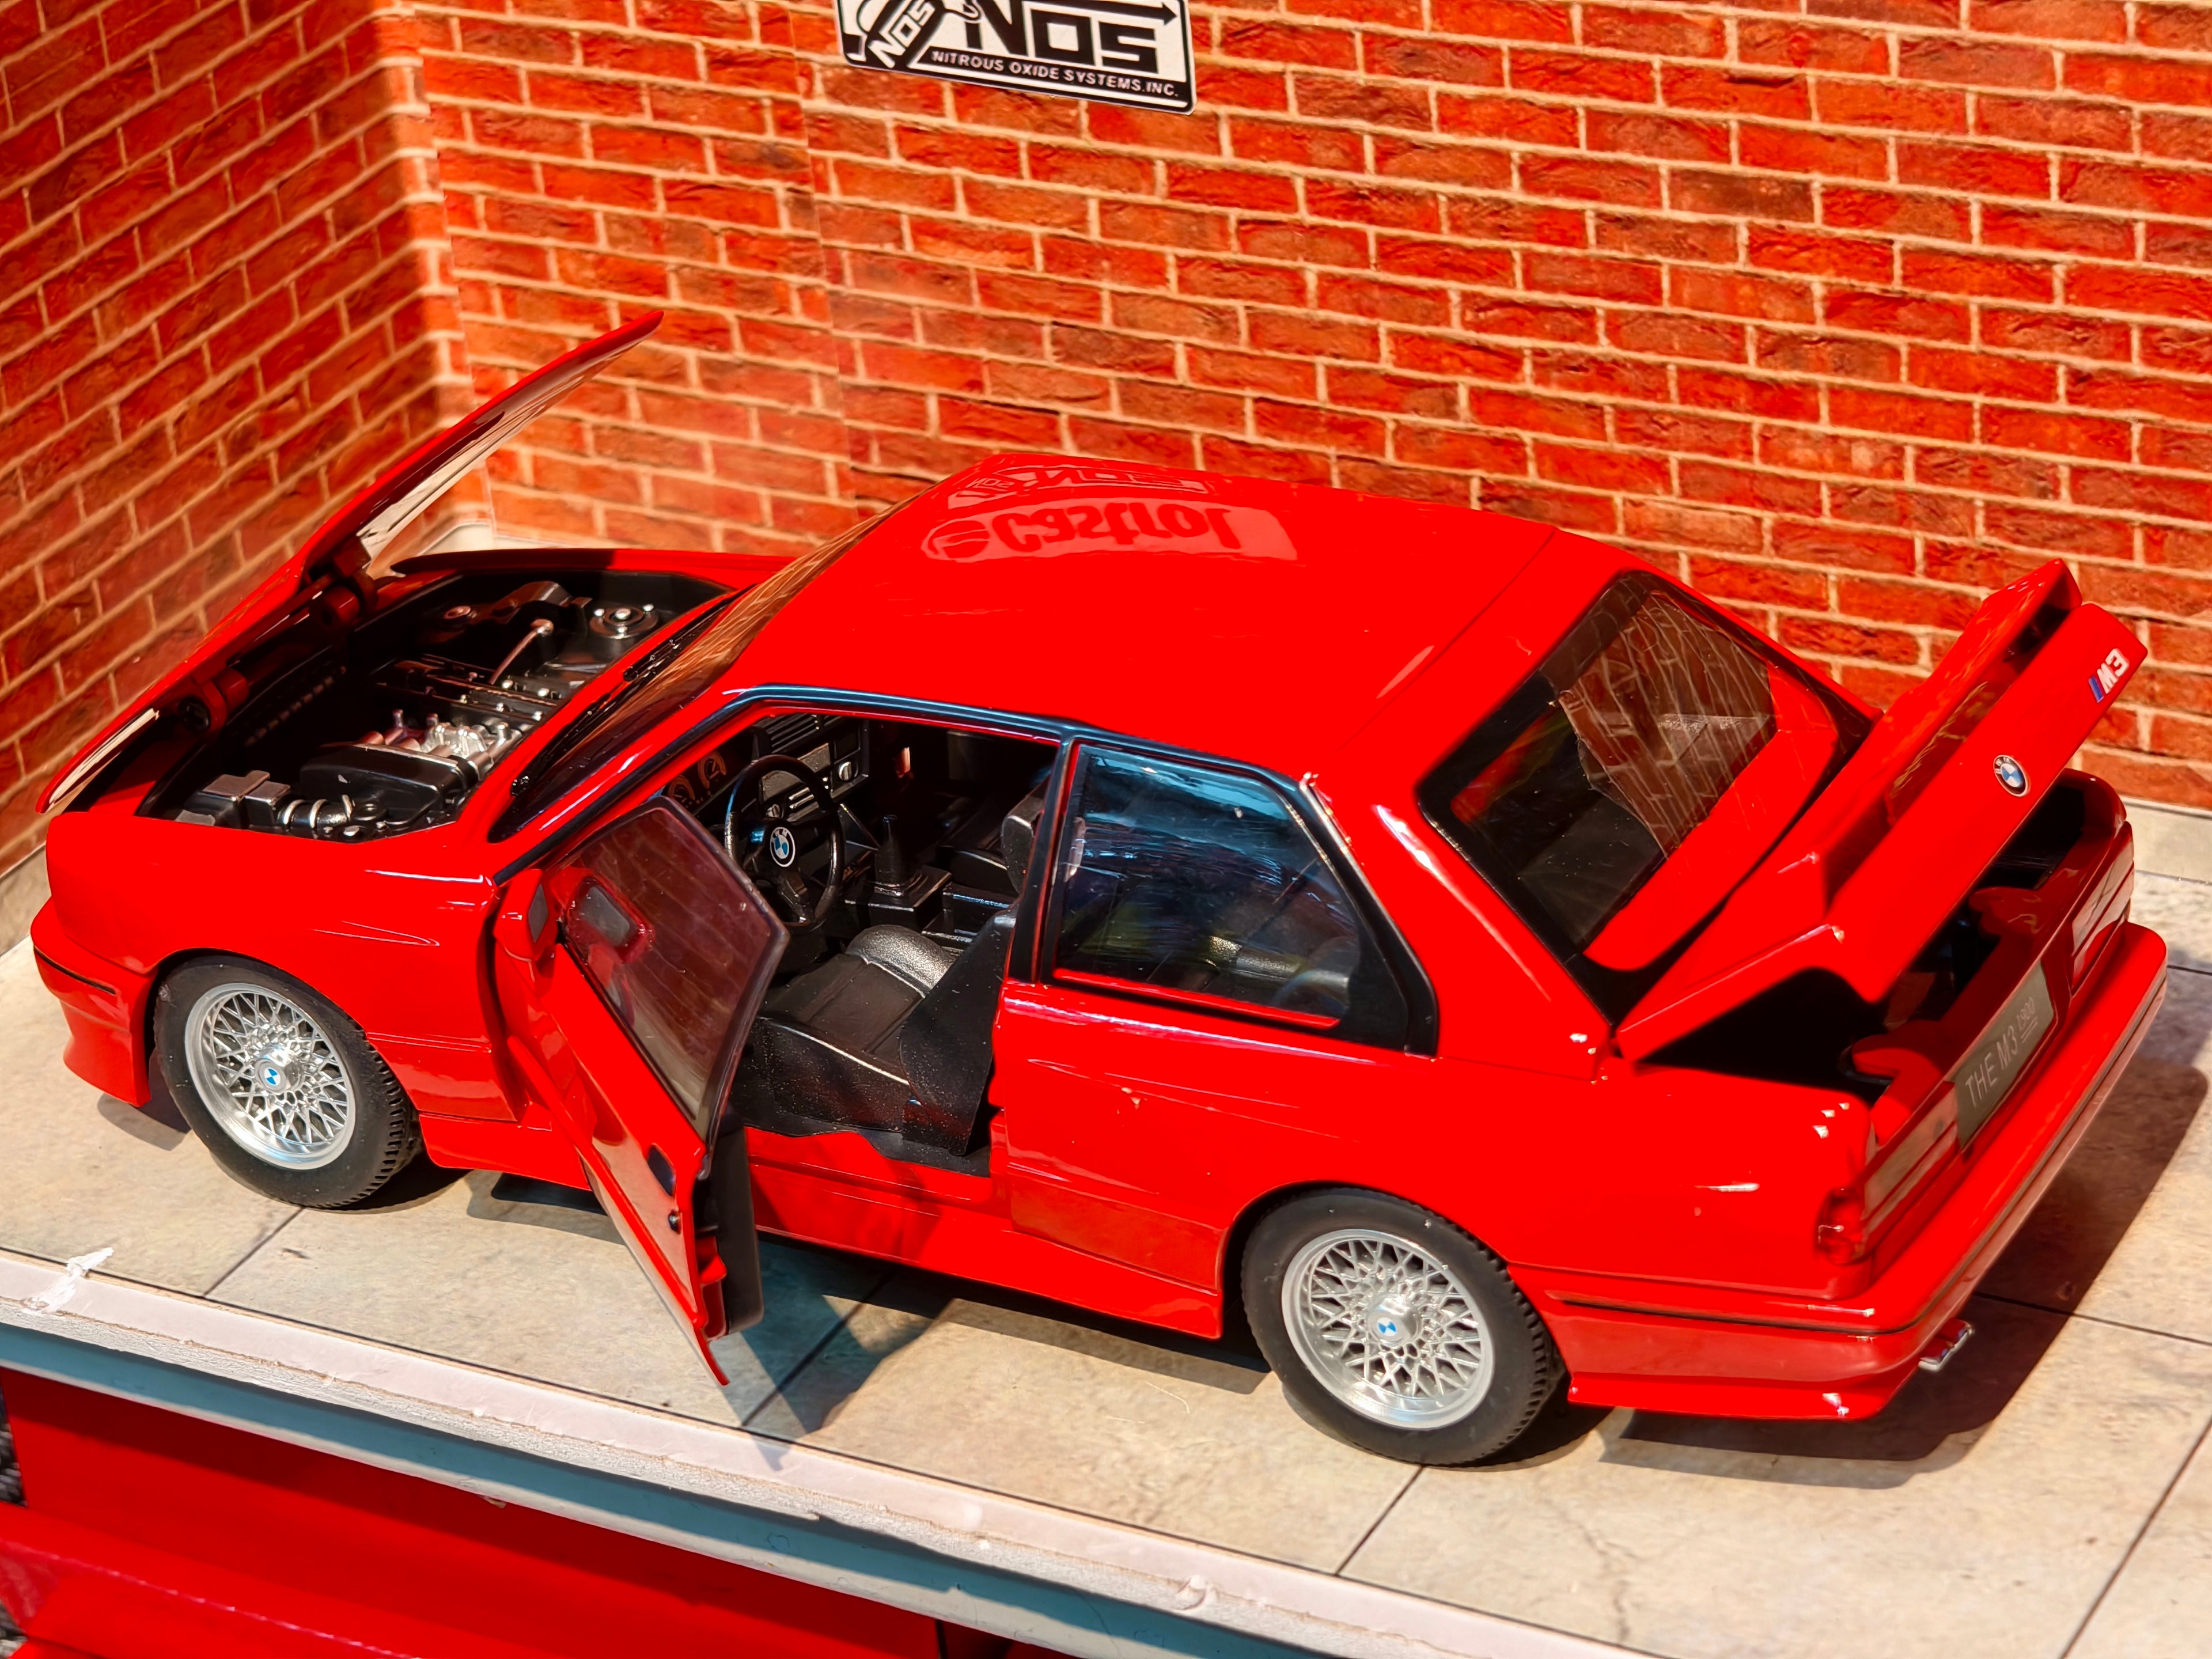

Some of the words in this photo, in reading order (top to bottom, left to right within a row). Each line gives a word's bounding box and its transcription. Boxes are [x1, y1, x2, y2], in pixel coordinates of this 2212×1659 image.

[868, 0, 936, 68] NOS
[931, 50, 1004, 71] NITROUS
[1009, 61, 1059, 80] OXIDE
[964, 0, 1160, 74] NOS
[2097, 648, 2130, 694] M3
[1965, 1052, 1999, 1108] THE
[1996, 1025, 2018, 1070] M3
